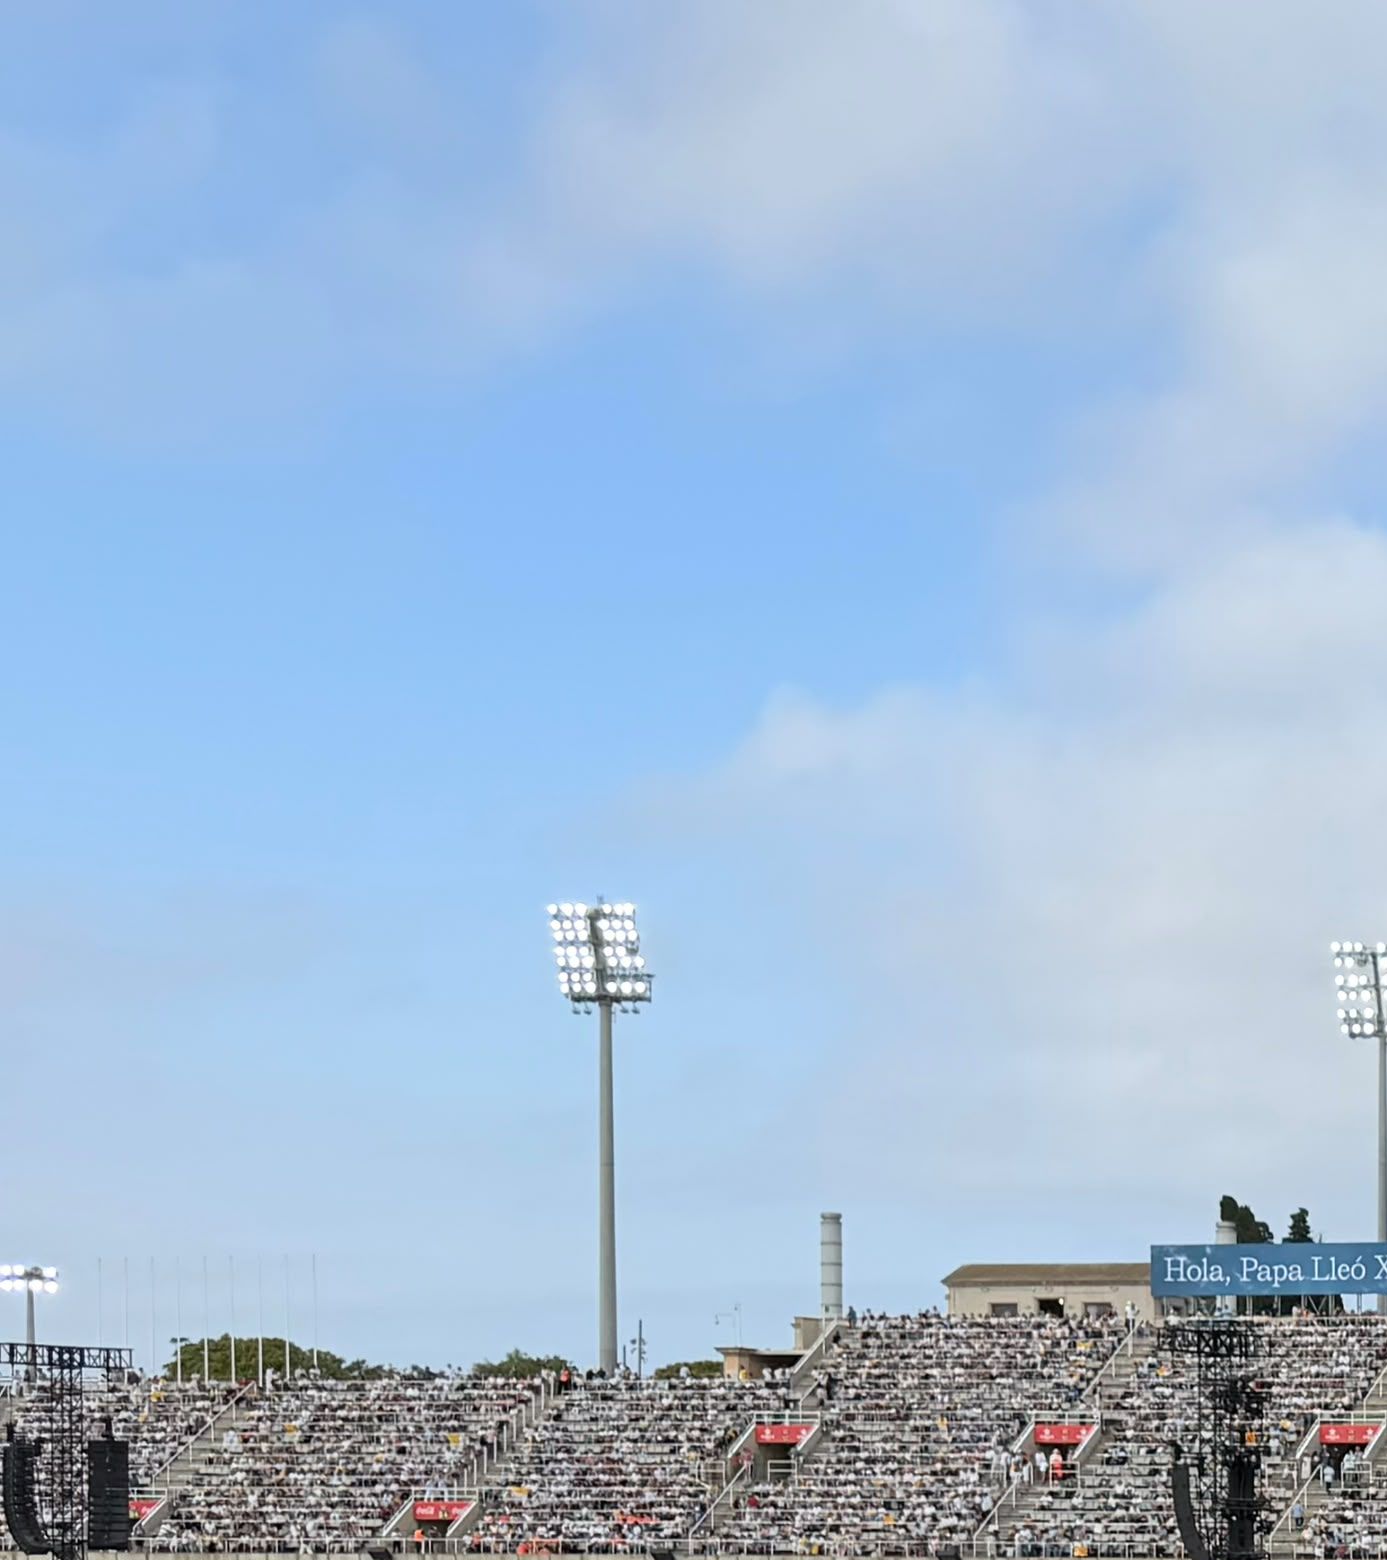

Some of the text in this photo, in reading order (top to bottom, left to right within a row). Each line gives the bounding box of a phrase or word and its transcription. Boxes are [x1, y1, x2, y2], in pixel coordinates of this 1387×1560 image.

[1163, 1256, 1231, 1287] Hola,
[1239, 1256, 1305, 1288] Papa
[1311, 1255, 1366, 1281] Lleó
